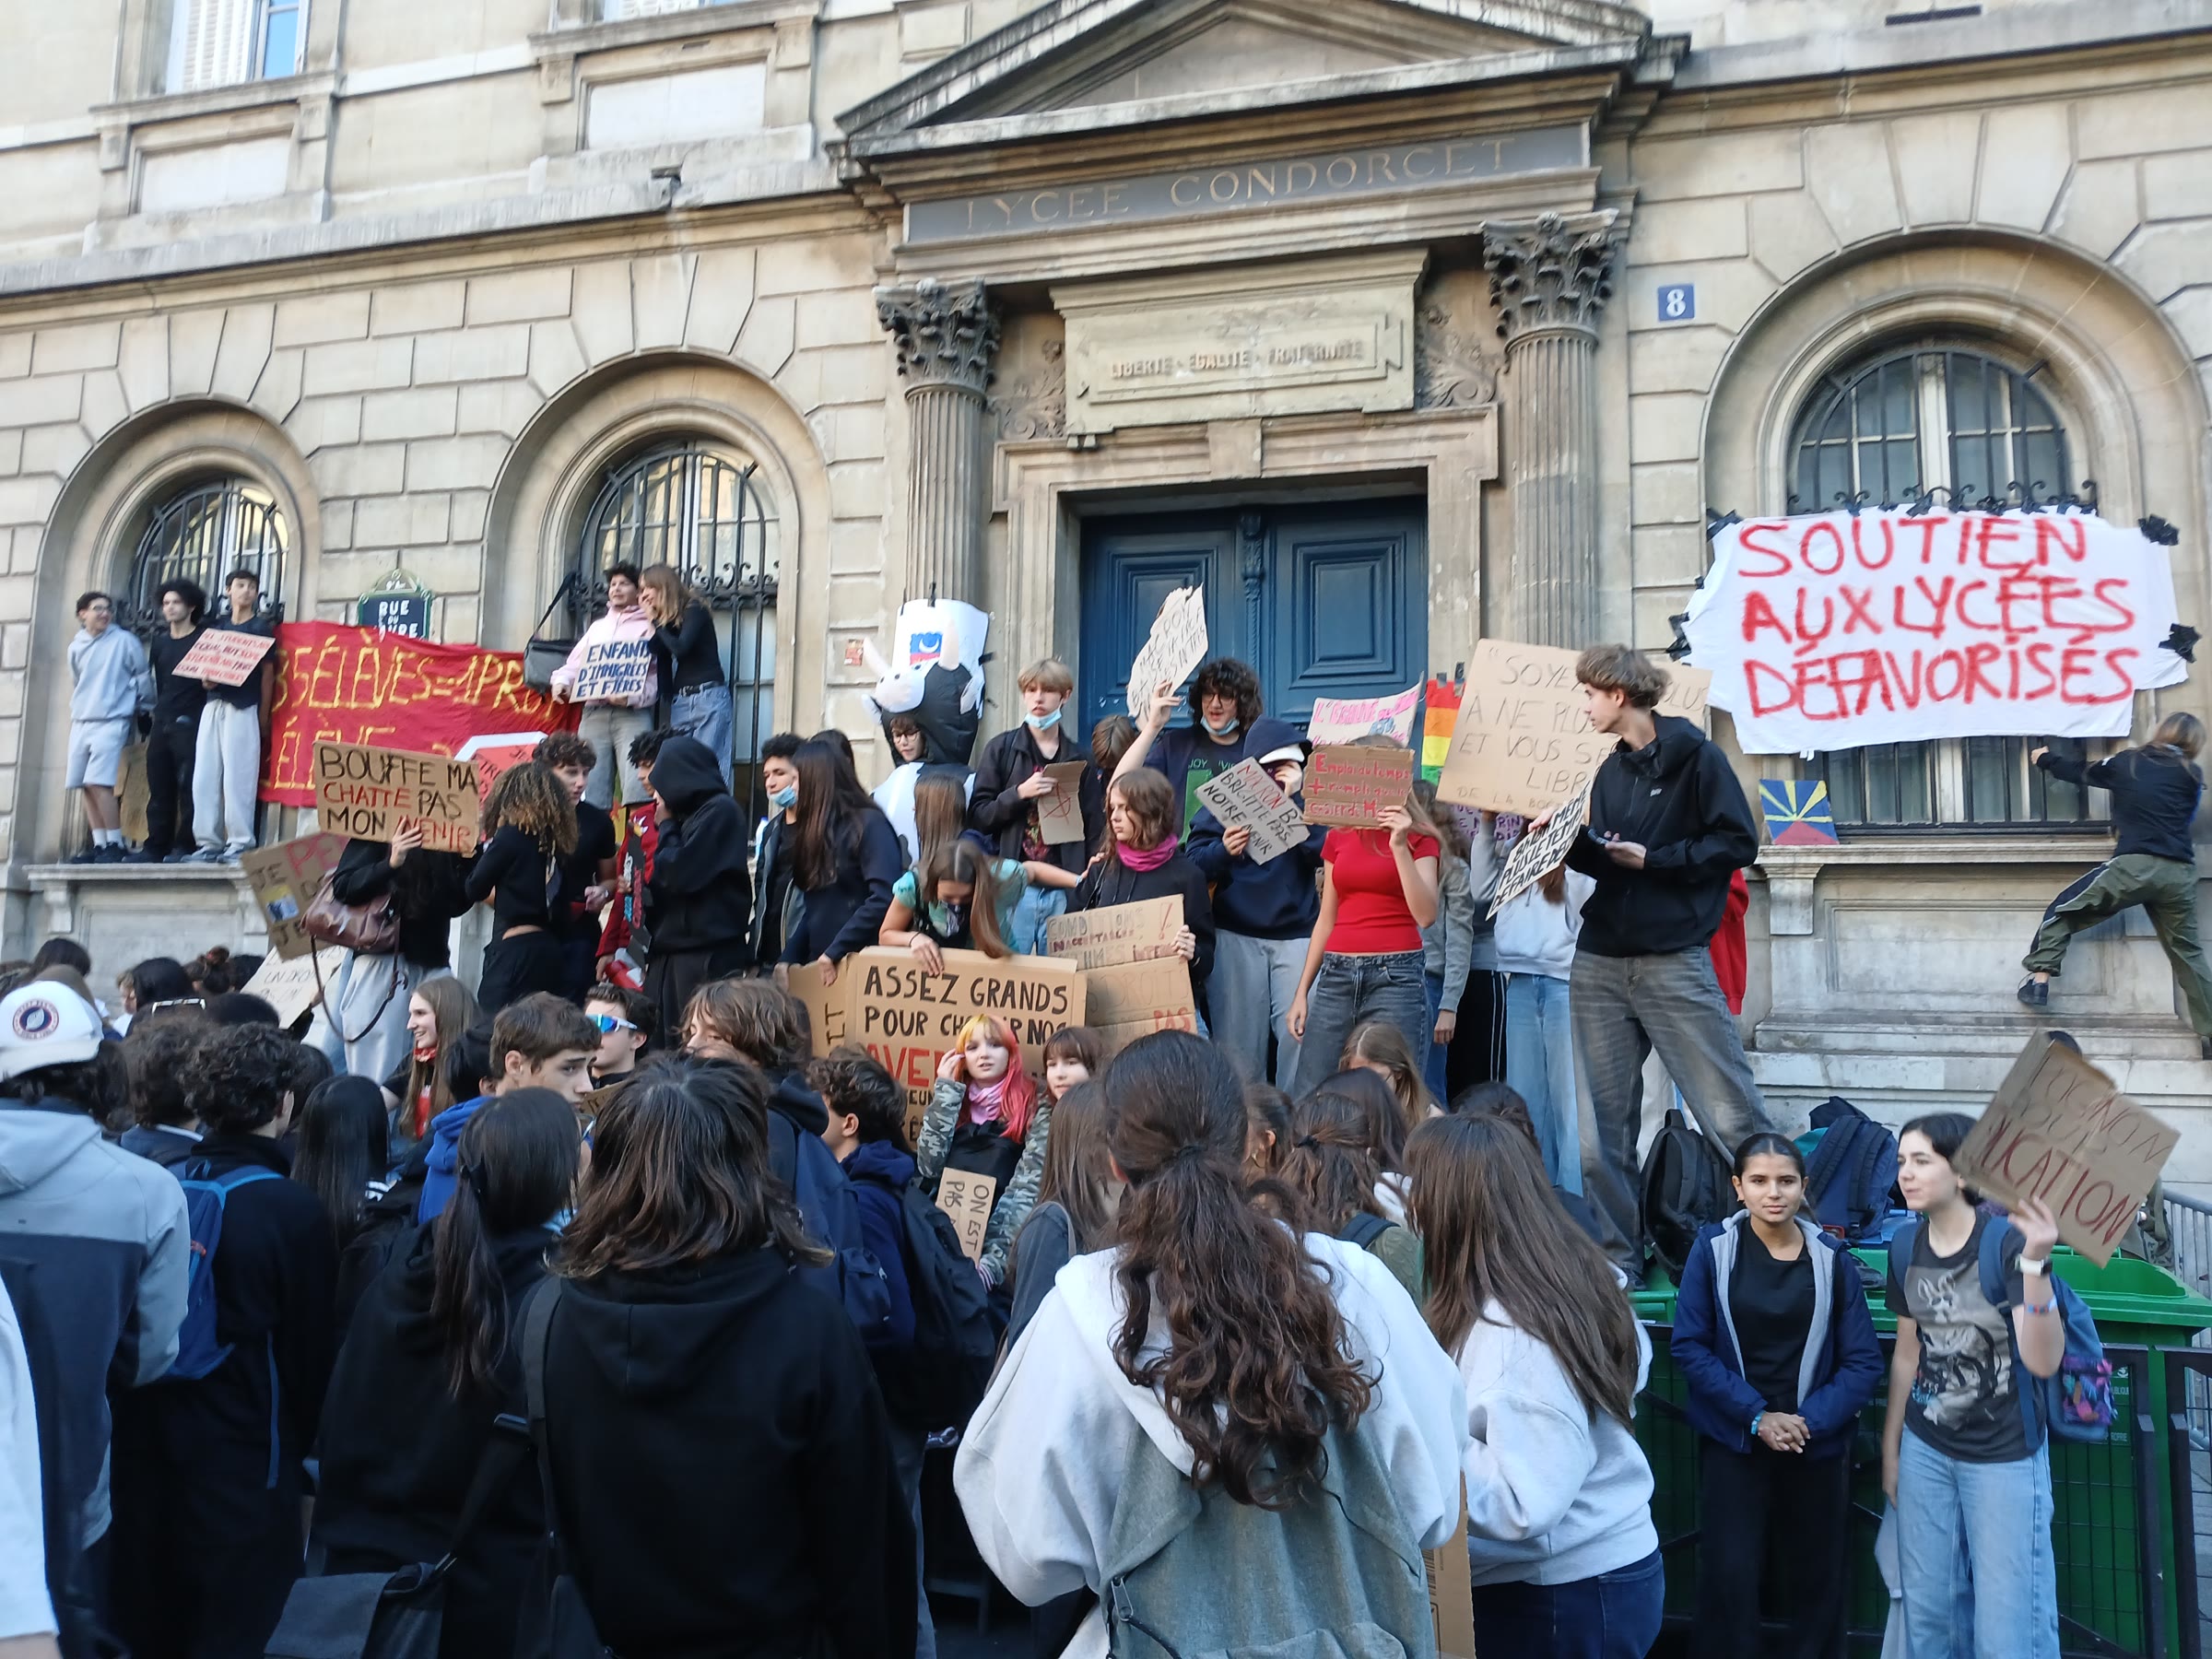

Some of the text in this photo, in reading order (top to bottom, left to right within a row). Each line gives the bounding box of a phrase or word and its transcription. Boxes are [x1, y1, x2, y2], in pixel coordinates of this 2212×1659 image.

[1170, 137, 1515, 207] CONDORCET
[1666, 288, 1687, 317] 8
[1738, 517, 2087, 577] SOUTIEN
[379, 599, 410, 616] RUE
[1742, 563, 2136, 642] AUX LYCÉES
[576, 681, 598, 698] ET
[1496, 697, 1545, 730] NE
[1188, 758, 1208, 769] JOY
[1459, 733, 1491, 755] ET
[1506, 735, 1564, 764] VOUS
[320, 747, 436, 785] BOUFFE
[447, 763, 478, 794] MA
[324, 782, 412, 809] CHATTE
[418, 790, 462, 820] PAS
[1203, 783, 1247, 825] NOTRE
[1220, 771, 1271, 822] BRIGITTE
[327, 806, 386, 835] MON
[1499, 847, 1530, 890] PLUS
[1527, 837, 1547, 865] LE
[865, 965, 960, 1006] ASSEZ
[970, 976, 1069, 1015] GRANDS
[865, 1006, 929, 1038] POUR
[944, 1181, 965, 1208] PAS
[965, 1184, 989, 1252] ON EST
